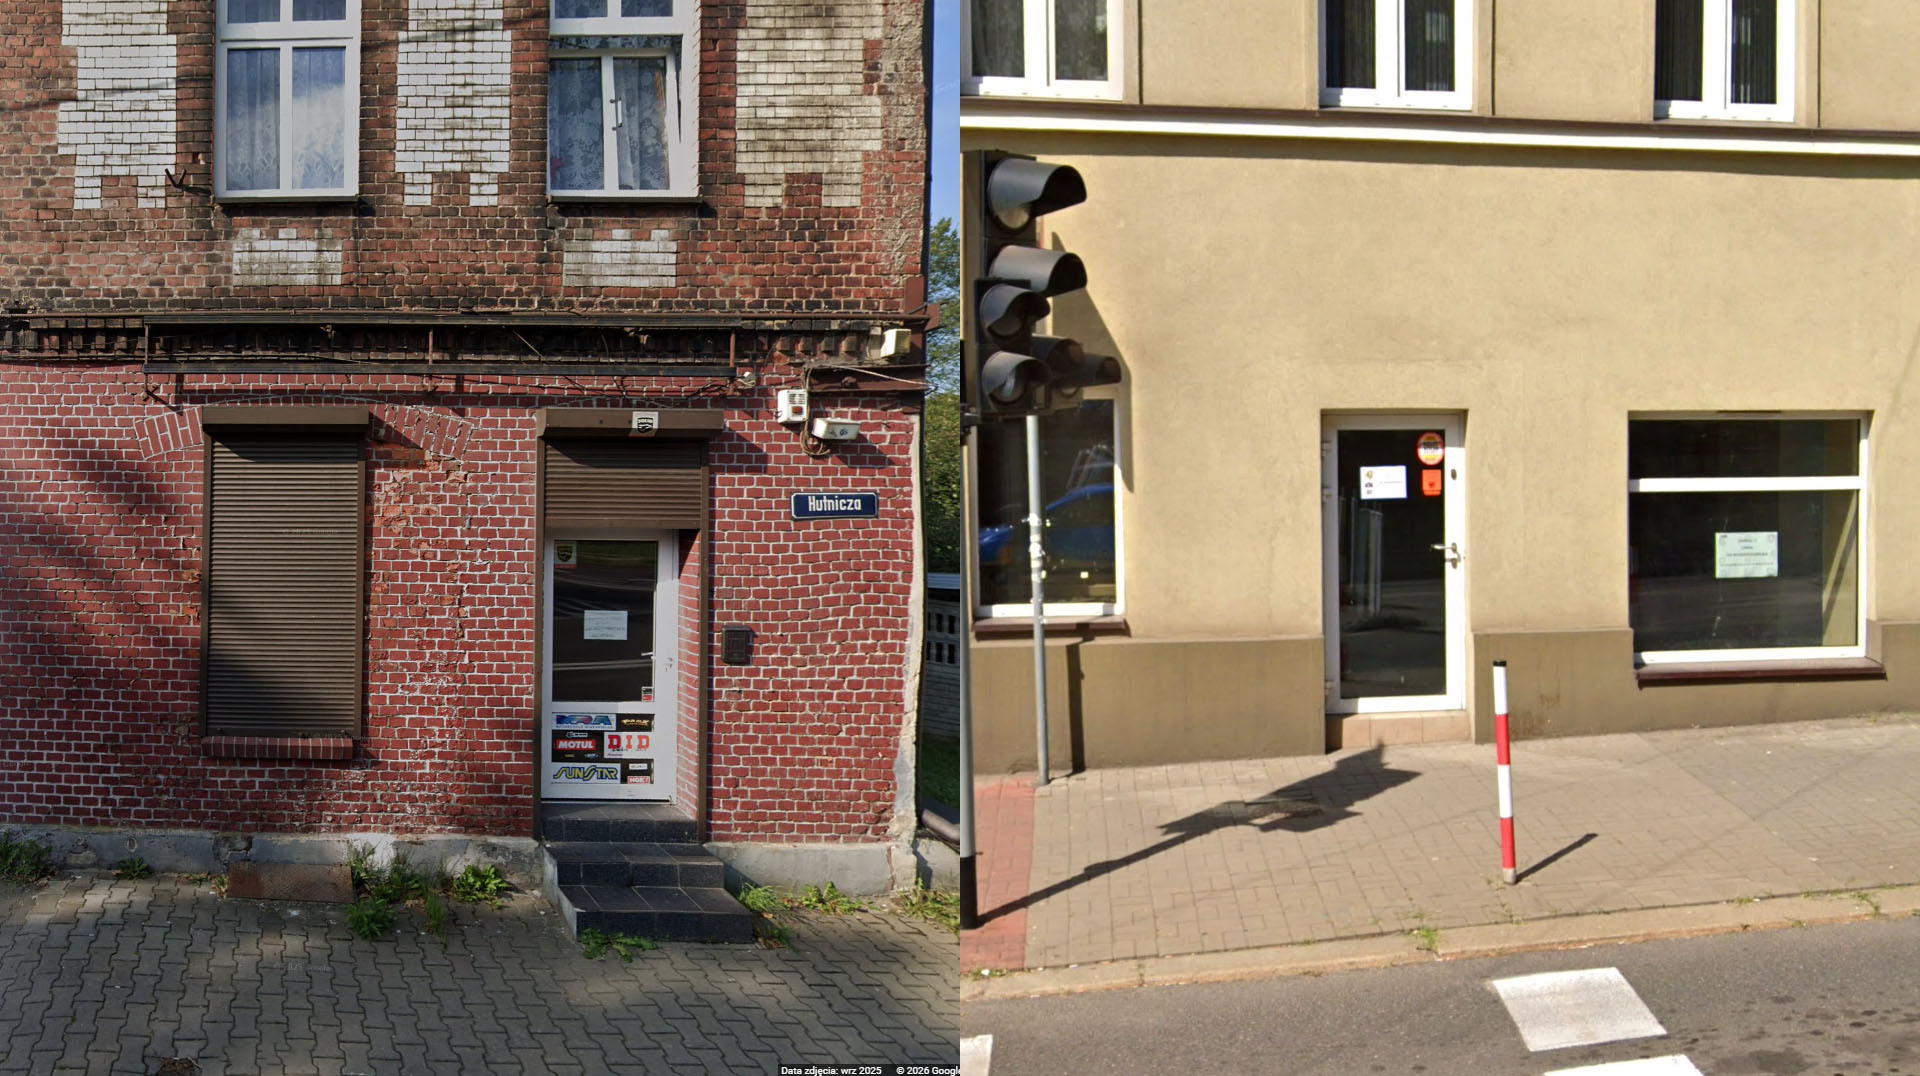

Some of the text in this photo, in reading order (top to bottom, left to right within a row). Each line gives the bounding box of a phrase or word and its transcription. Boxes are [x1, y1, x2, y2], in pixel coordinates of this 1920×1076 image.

[808, 495, 862, 511] Hutnicza
[558, 740, 594, 749] MOTUL
[608, 735, 650, 749] DID
[553, 765, 618, 781] SUNSTAR
